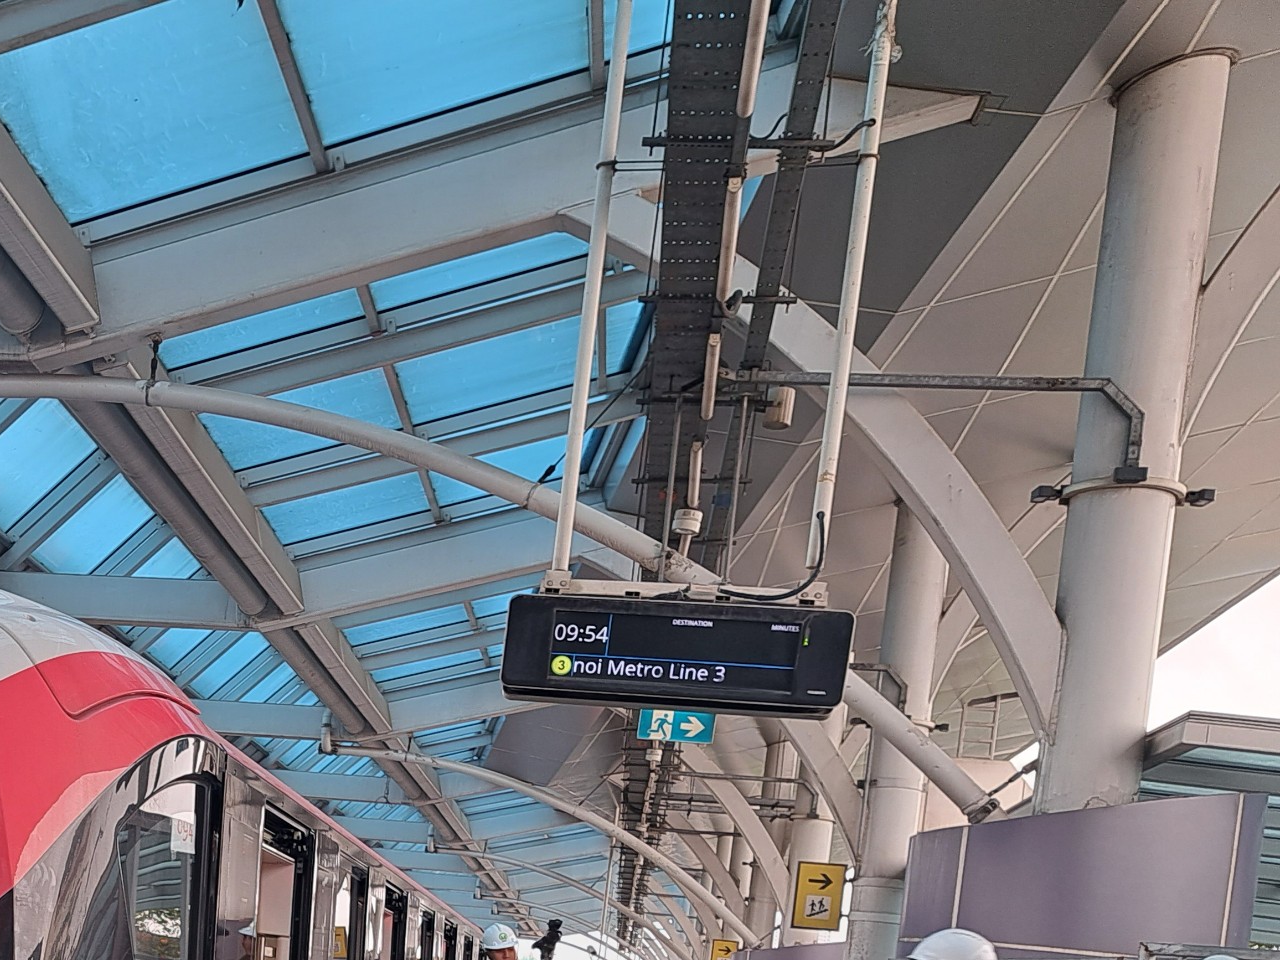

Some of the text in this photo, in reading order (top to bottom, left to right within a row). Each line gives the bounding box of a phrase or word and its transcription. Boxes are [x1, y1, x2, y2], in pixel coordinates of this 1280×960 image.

[672, 618, 713, 628] DESTINATION
[771, 623, 800, 633] MINUTES
[554, 623, 609, 643] 09:54
[557, 659, 566, 671] 3
[573, 658, 726, 683] noi Metro Line 3
